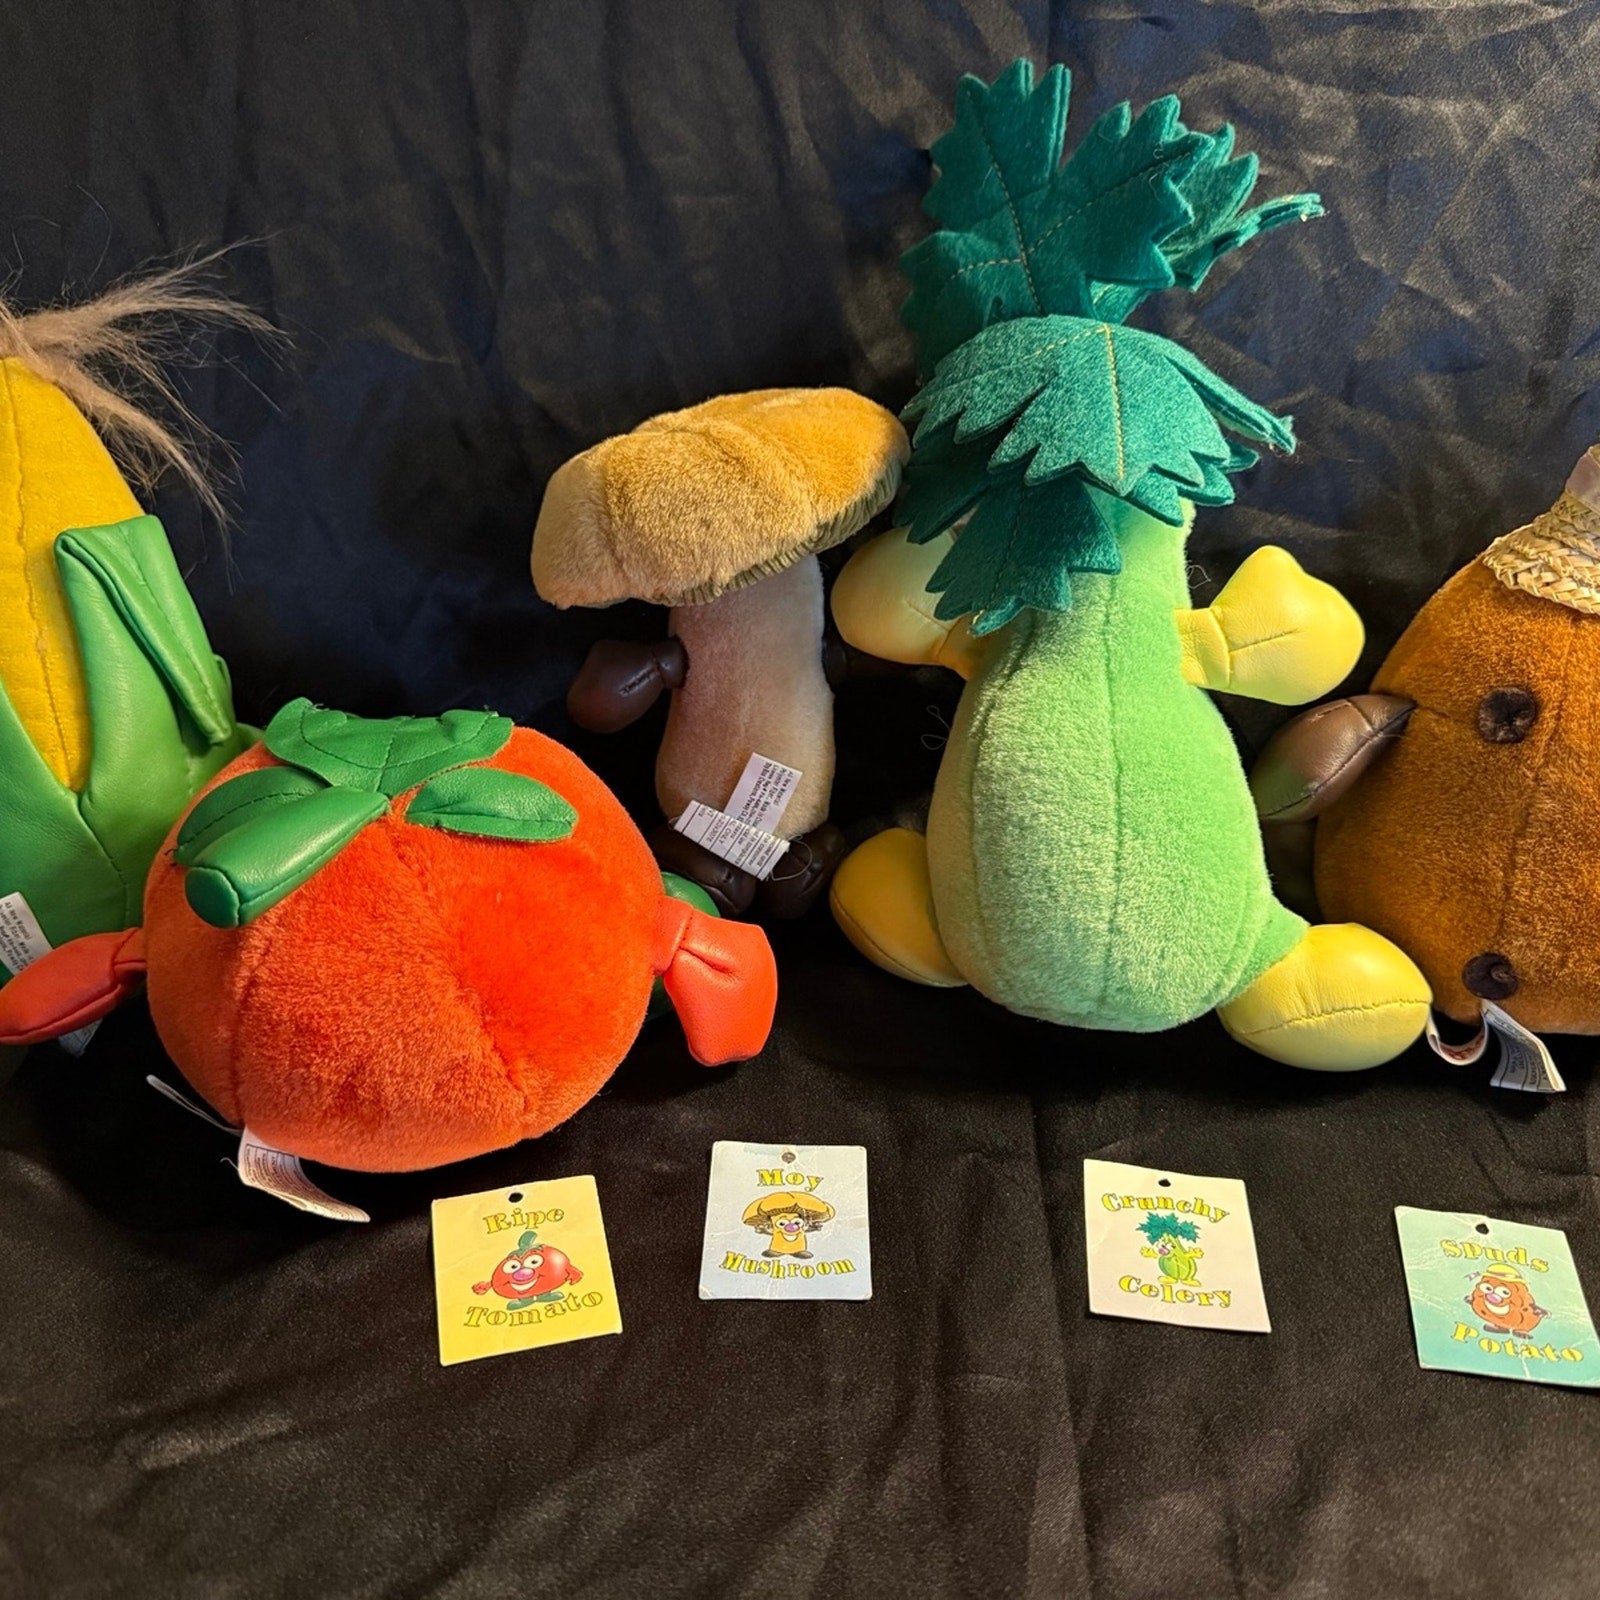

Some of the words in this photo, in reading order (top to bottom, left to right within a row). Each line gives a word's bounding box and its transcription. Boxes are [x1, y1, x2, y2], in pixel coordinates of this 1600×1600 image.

[757, 1168, 824, 1192] Moy
[483, 1207, 565, 1234] Ripe
[1101, 1193, 1230, 1223] Crunchy
[719, 1251, 856, 1279] Mushroom
[1440, 1239, 1549, 1273] Spuds
[1118, 1274, 1232, 1308] Celery
[464, 1291, 603, 1327] Tomato
[1450, 1321, 1584, 1362] Potato
